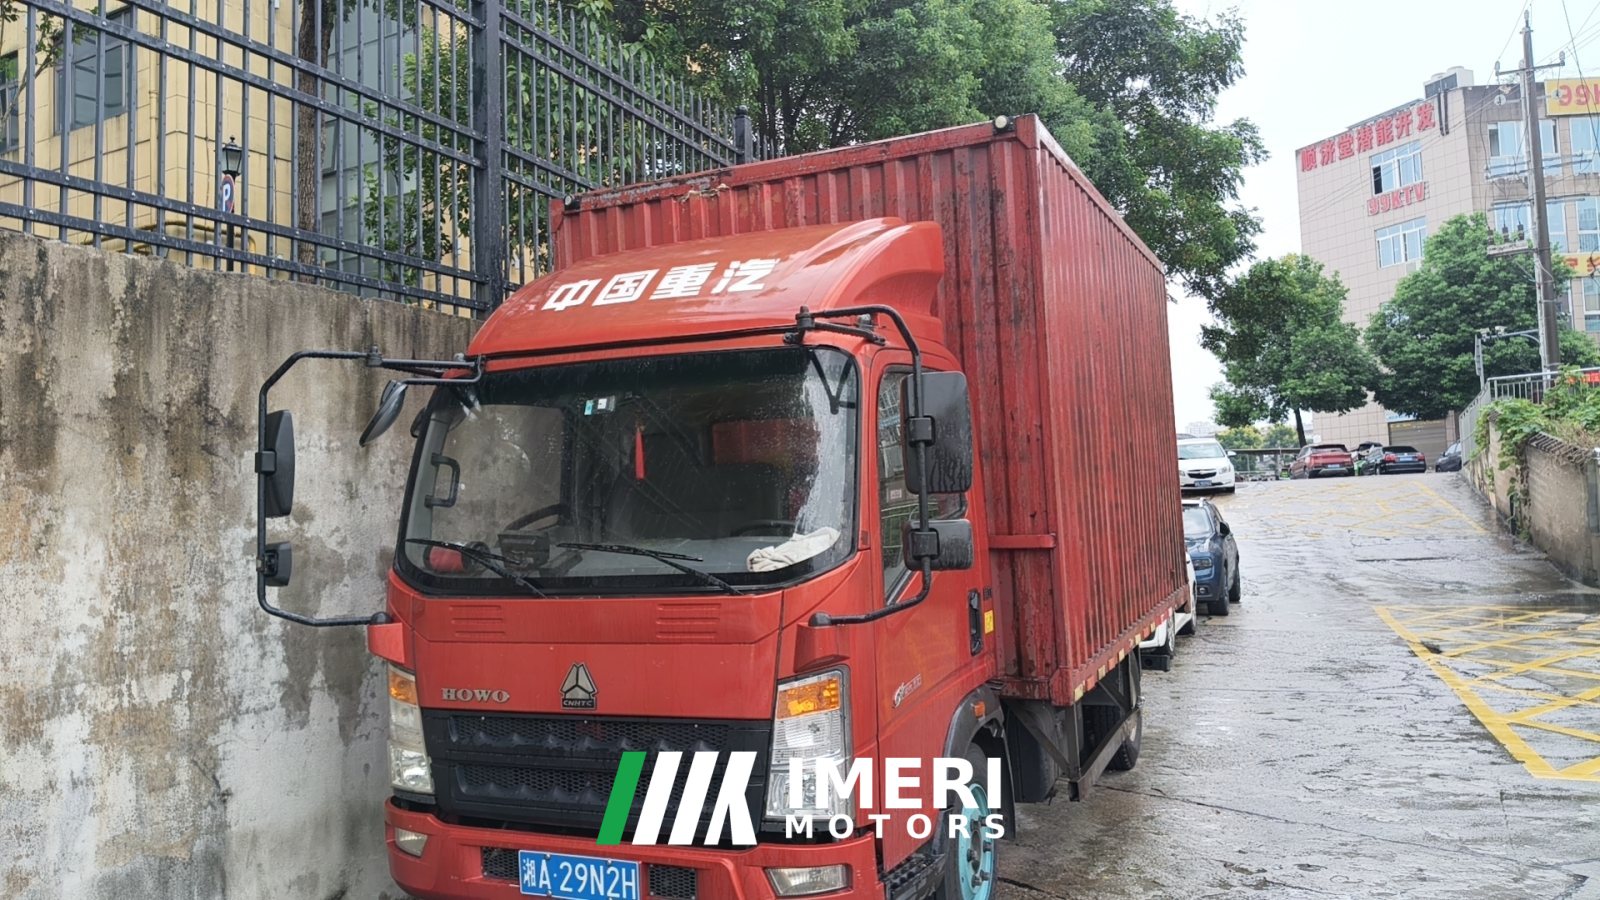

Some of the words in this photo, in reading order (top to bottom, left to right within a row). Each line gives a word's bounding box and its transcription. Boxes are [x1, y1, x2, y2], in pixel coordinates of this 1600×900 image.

[1301, 102, 1435, 172] 顺济堂潜能开发
[1367, 181, 1425, 215] 99KTV
[541, 258, 780, 312] 中国重汽
[441, 688, 510, 703] HOWO
[563, 699, 593, 707] CNHTC
